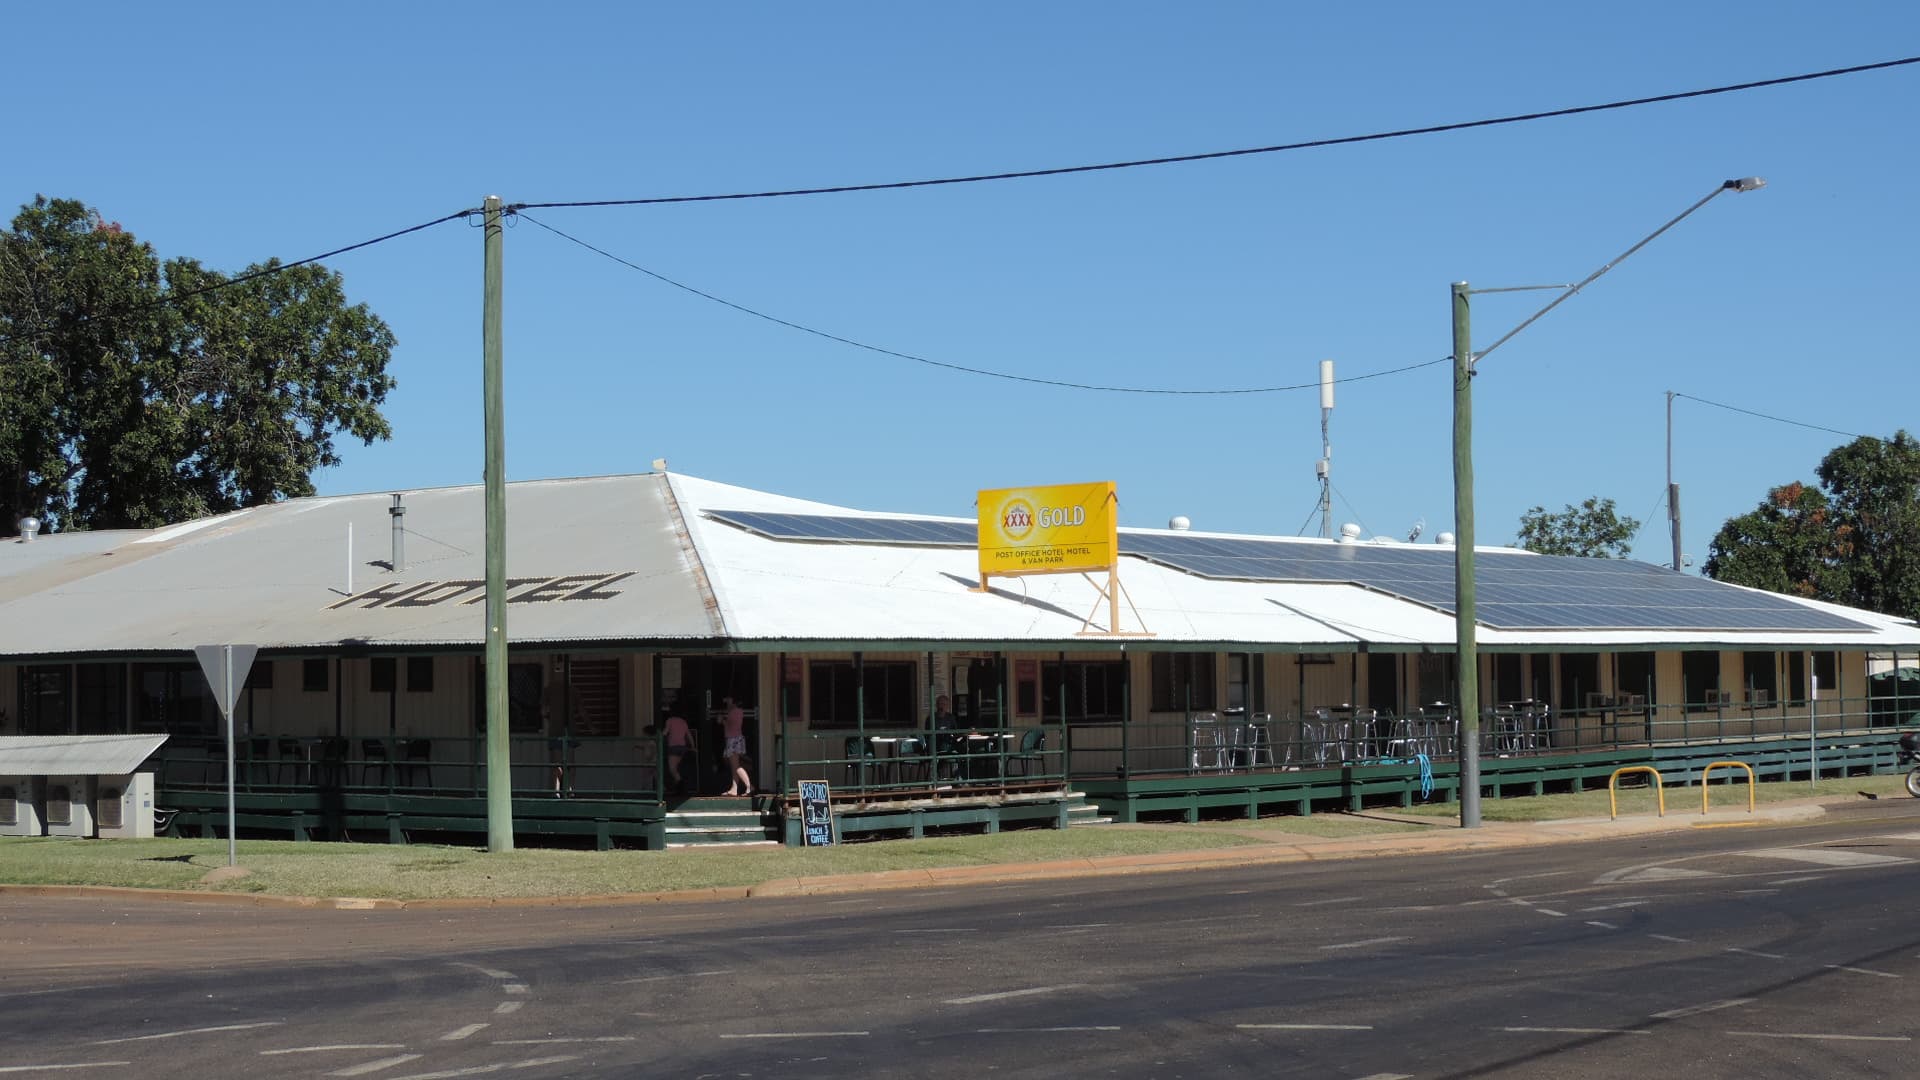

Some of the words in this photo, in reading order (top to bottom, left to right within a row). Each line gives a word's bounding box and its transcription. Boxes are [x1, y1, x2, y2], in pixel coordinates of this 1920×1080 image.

[1003, 513, 1033, 528] XXXX
[1038, 505, 1086, 528] GOLD
[996, 551, 1013, 559] POST
[1015, 549, 1040, 557] OFFICE
[1042, 548, 1064, 556] HOTEL
[1067, 547, 1091, 555] MOTEL
[325, 571, 639, 610] HOTEL
